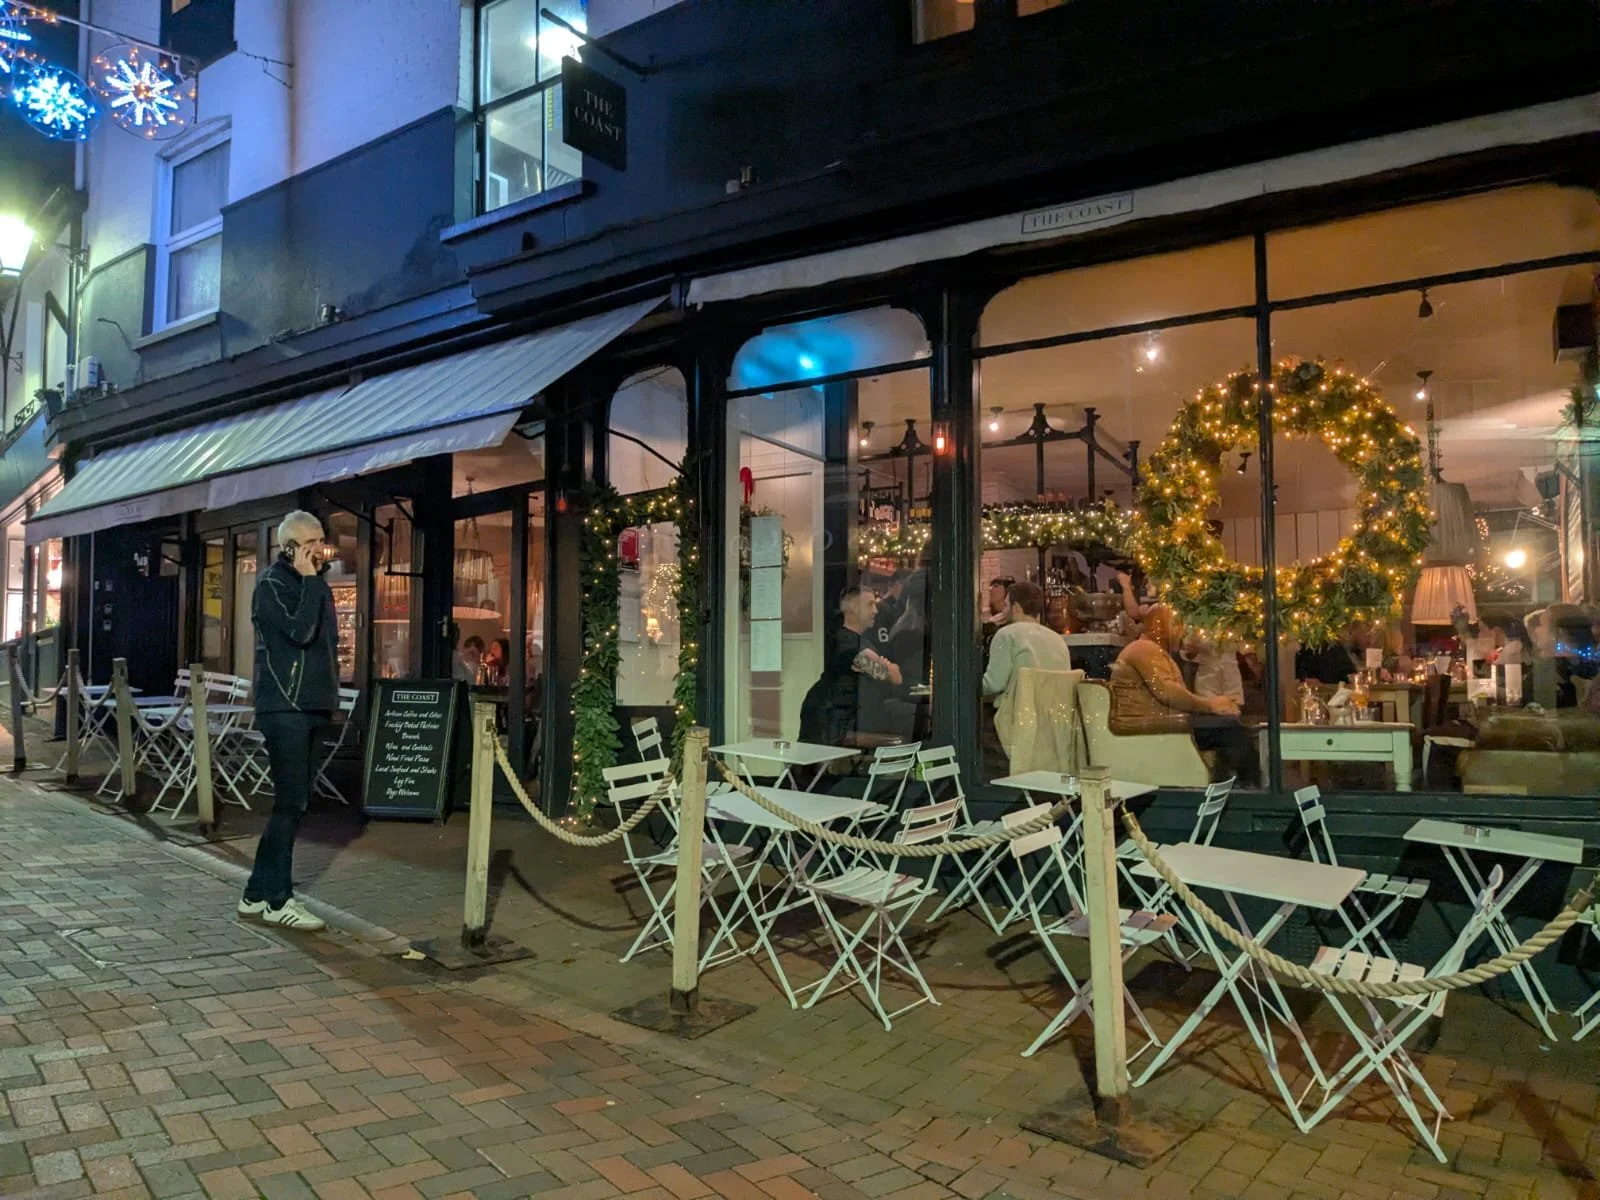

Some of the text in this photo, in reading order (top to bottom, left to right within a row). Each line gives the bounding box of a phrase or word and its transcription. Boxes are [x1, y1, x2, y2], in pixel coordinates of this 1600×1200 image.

[584, 89, 613, 118] THE
[574, 106, 621, 141] COAST
[1031, 212, 1064, 228] THE
